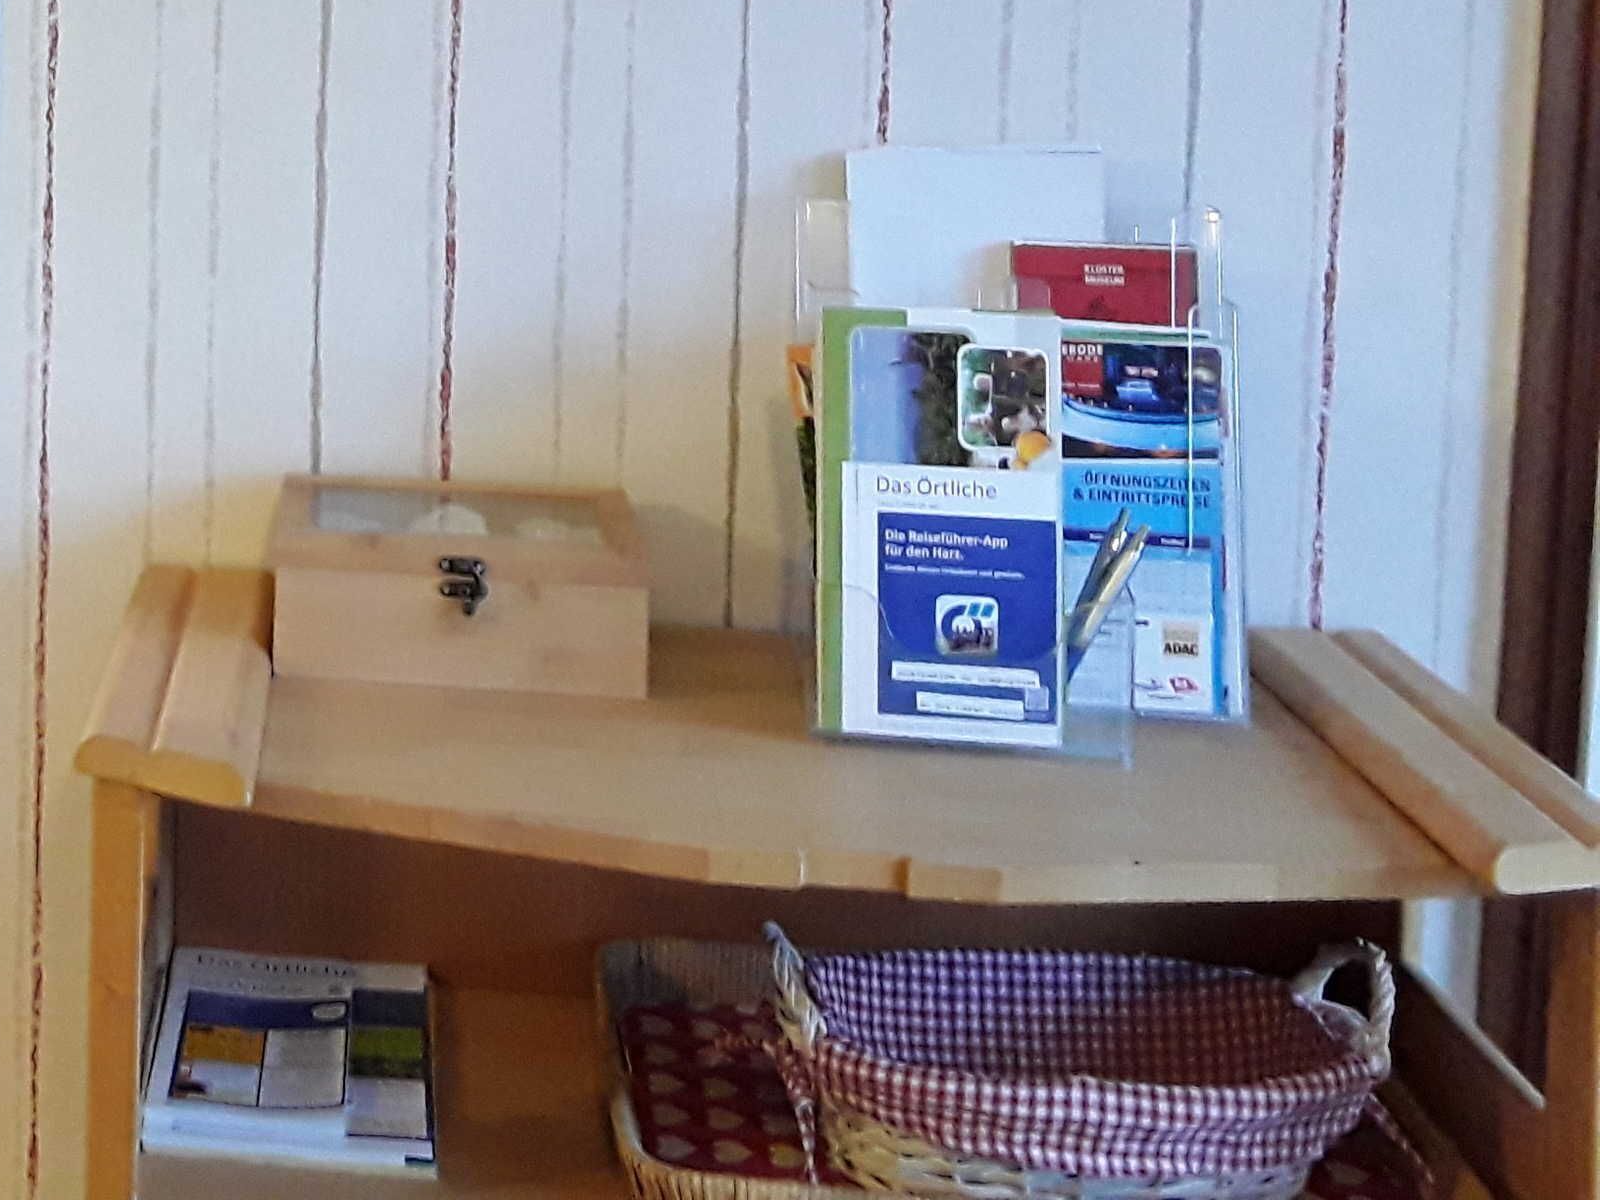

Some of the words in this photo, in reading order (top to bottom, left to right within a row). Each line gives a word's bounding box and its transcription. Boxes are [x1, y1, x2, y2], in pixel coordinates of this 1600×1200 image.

[876, 476, 911, 494] Das
[917, 475, 998, 499] Örtliche
[1163, 641, 1199, 657] ADAC
